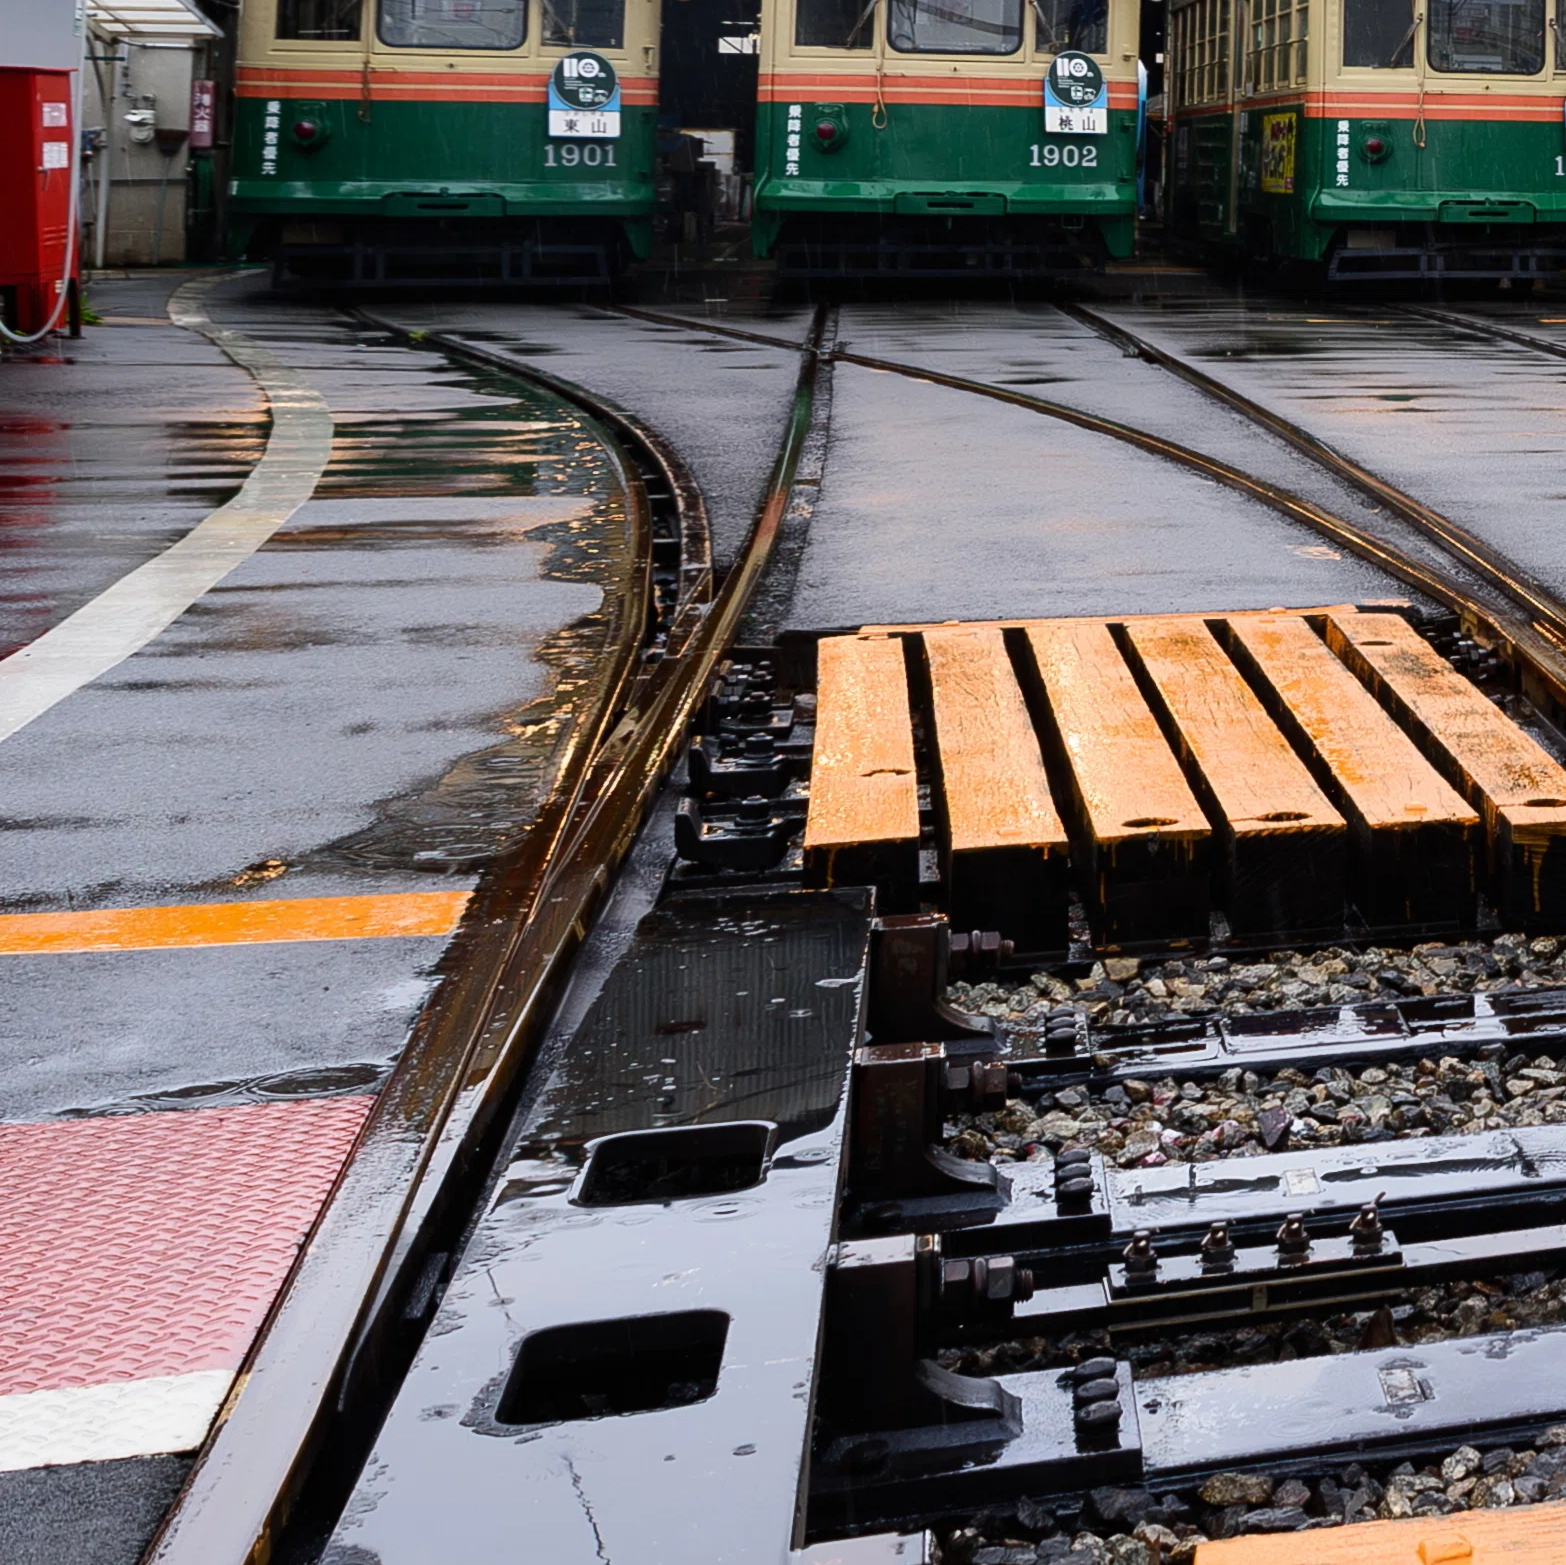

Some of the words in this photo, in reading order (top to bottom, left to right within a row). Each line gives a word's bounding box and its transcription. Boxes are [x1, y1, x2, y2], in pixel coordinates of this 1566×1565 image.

[563, 118, 607, 133] 東山
[1059, 116, 1096, 131] 桃山
[544, 144, 617, 167] 1901
[1029, 144, 1097, 167] 1902
